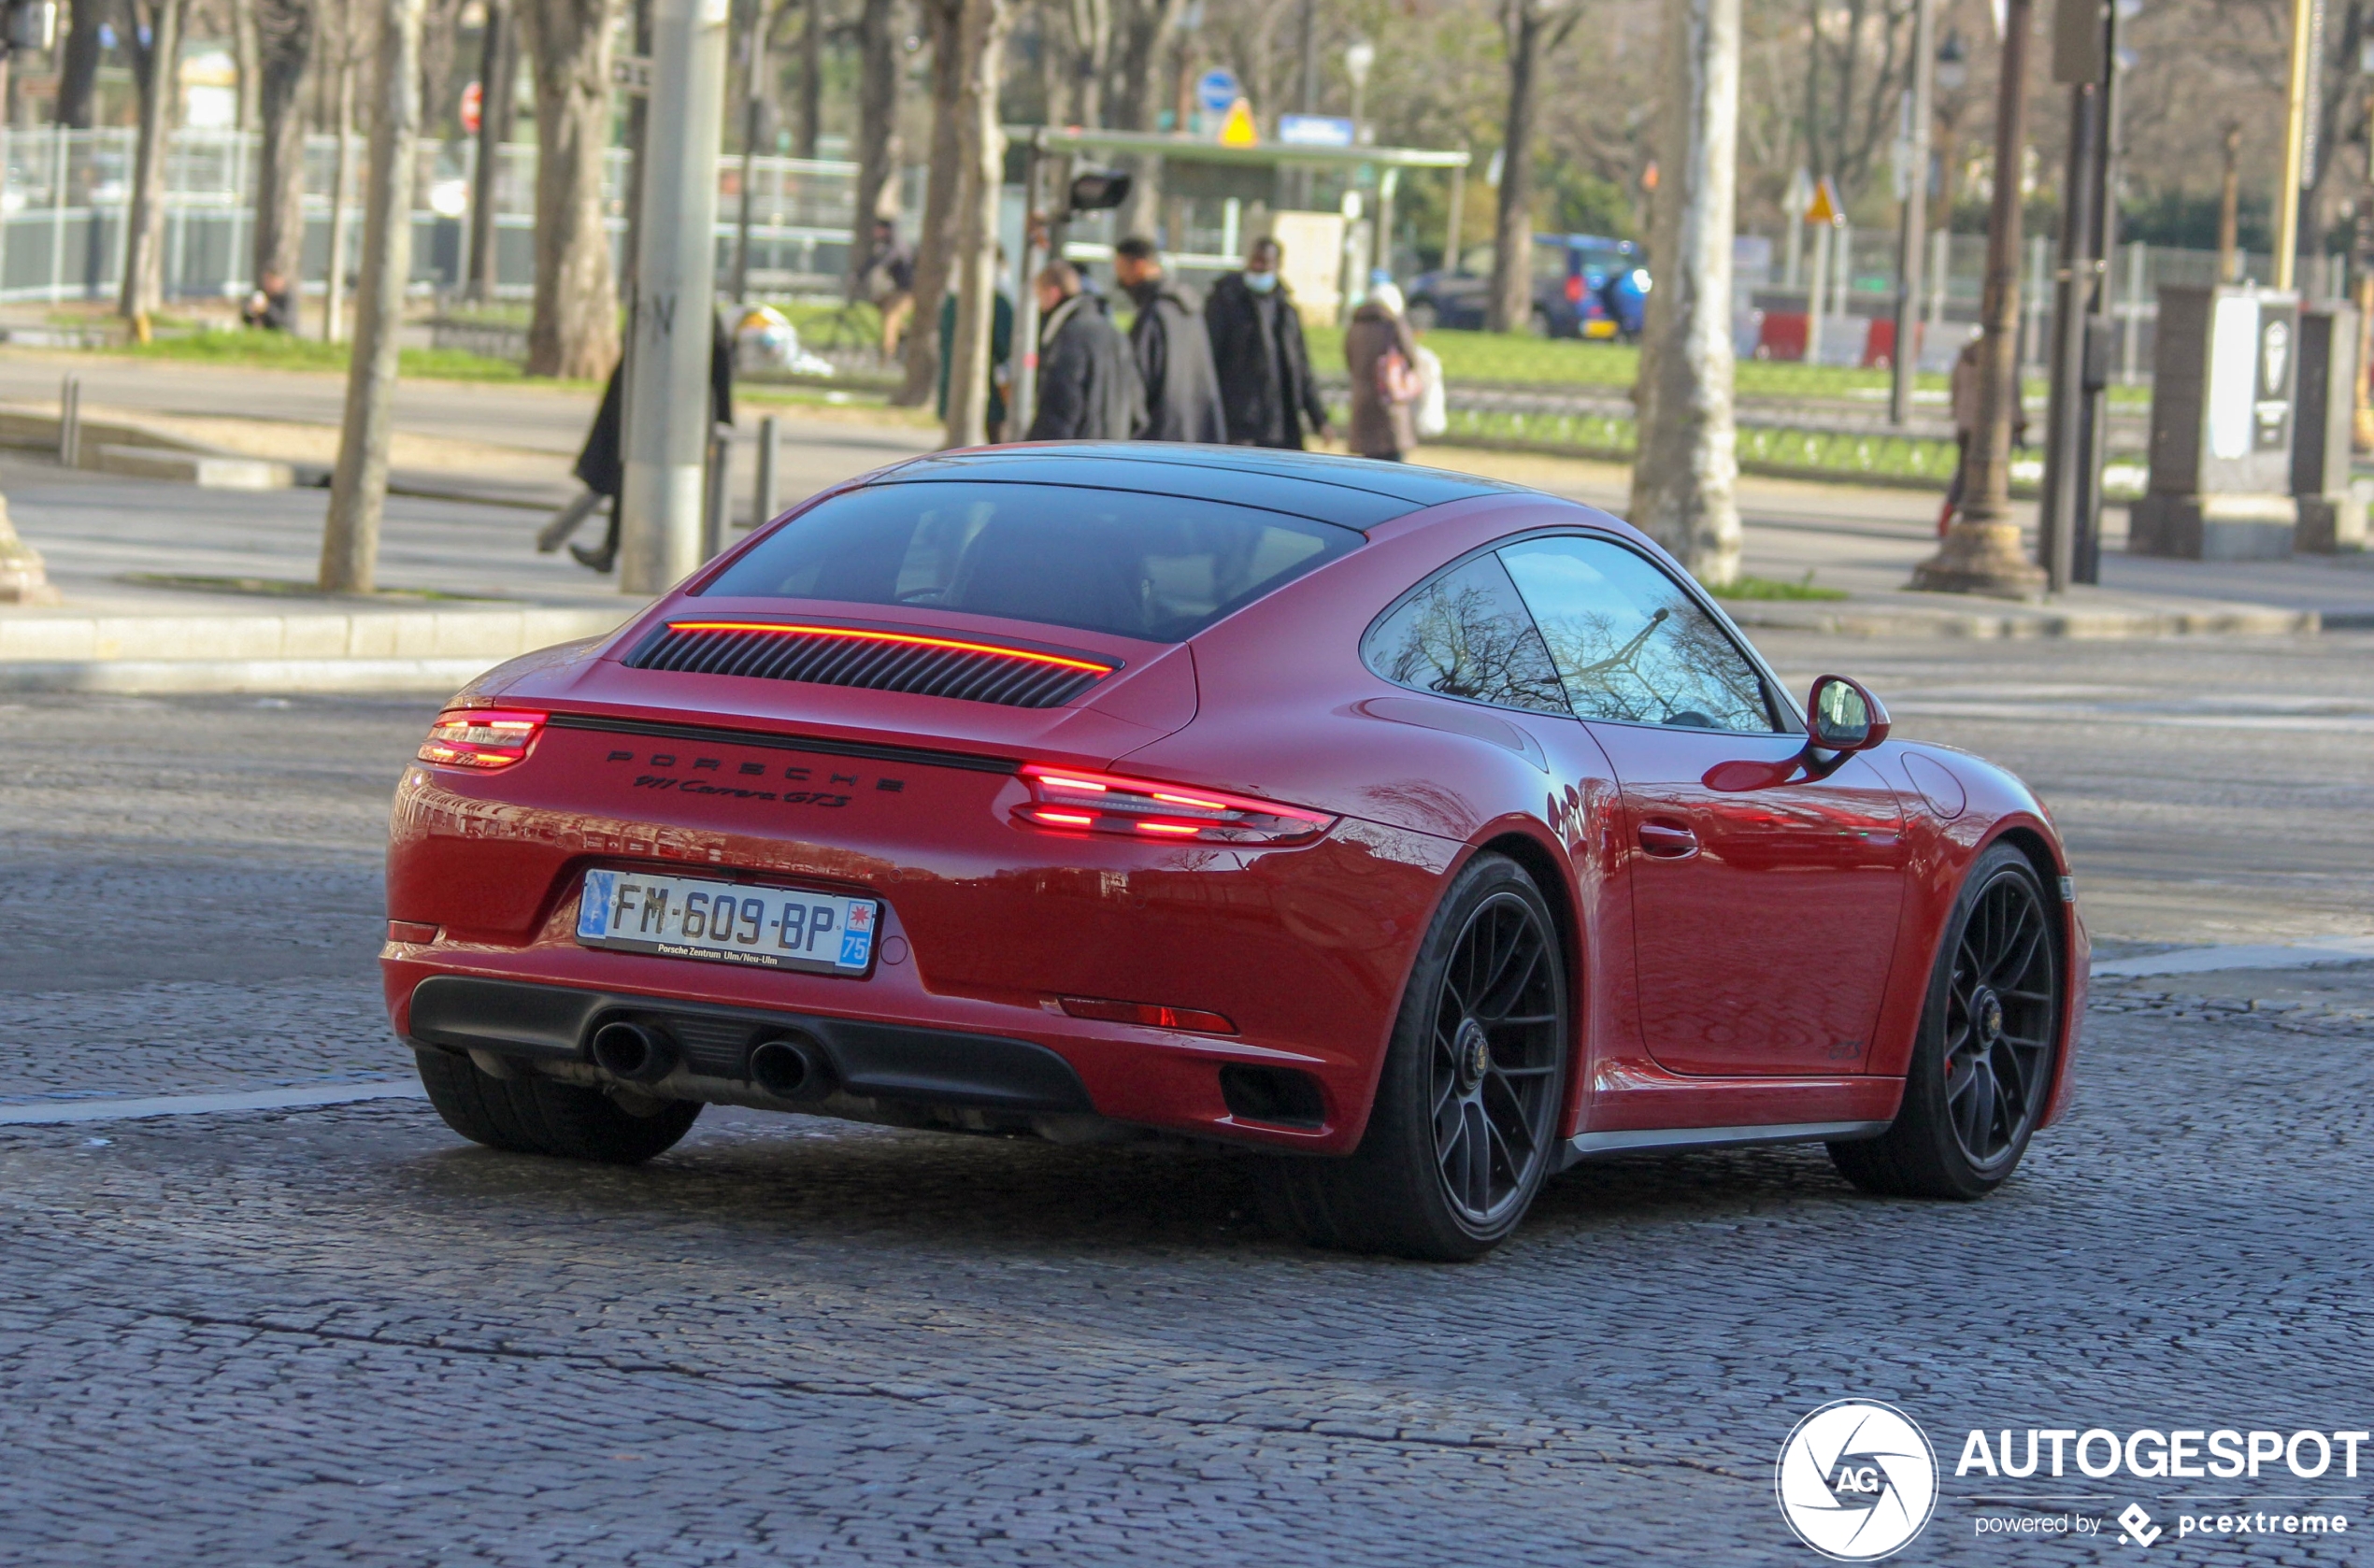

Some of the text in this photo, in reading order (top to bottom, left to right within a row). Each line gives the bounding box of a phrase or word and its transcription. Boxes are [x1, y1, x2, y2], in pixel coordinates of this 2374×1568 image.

[608, 750, 904, 791] PORSCHE
[633, 775, 851, 806] 911 Carrera GTS
[613, 884, 835, 951] FM-609-BP
[658, 944, 778, 965] Porsche Zentrum Ulm/Neu-Ulm
[842, 936, 866, 960] 75
